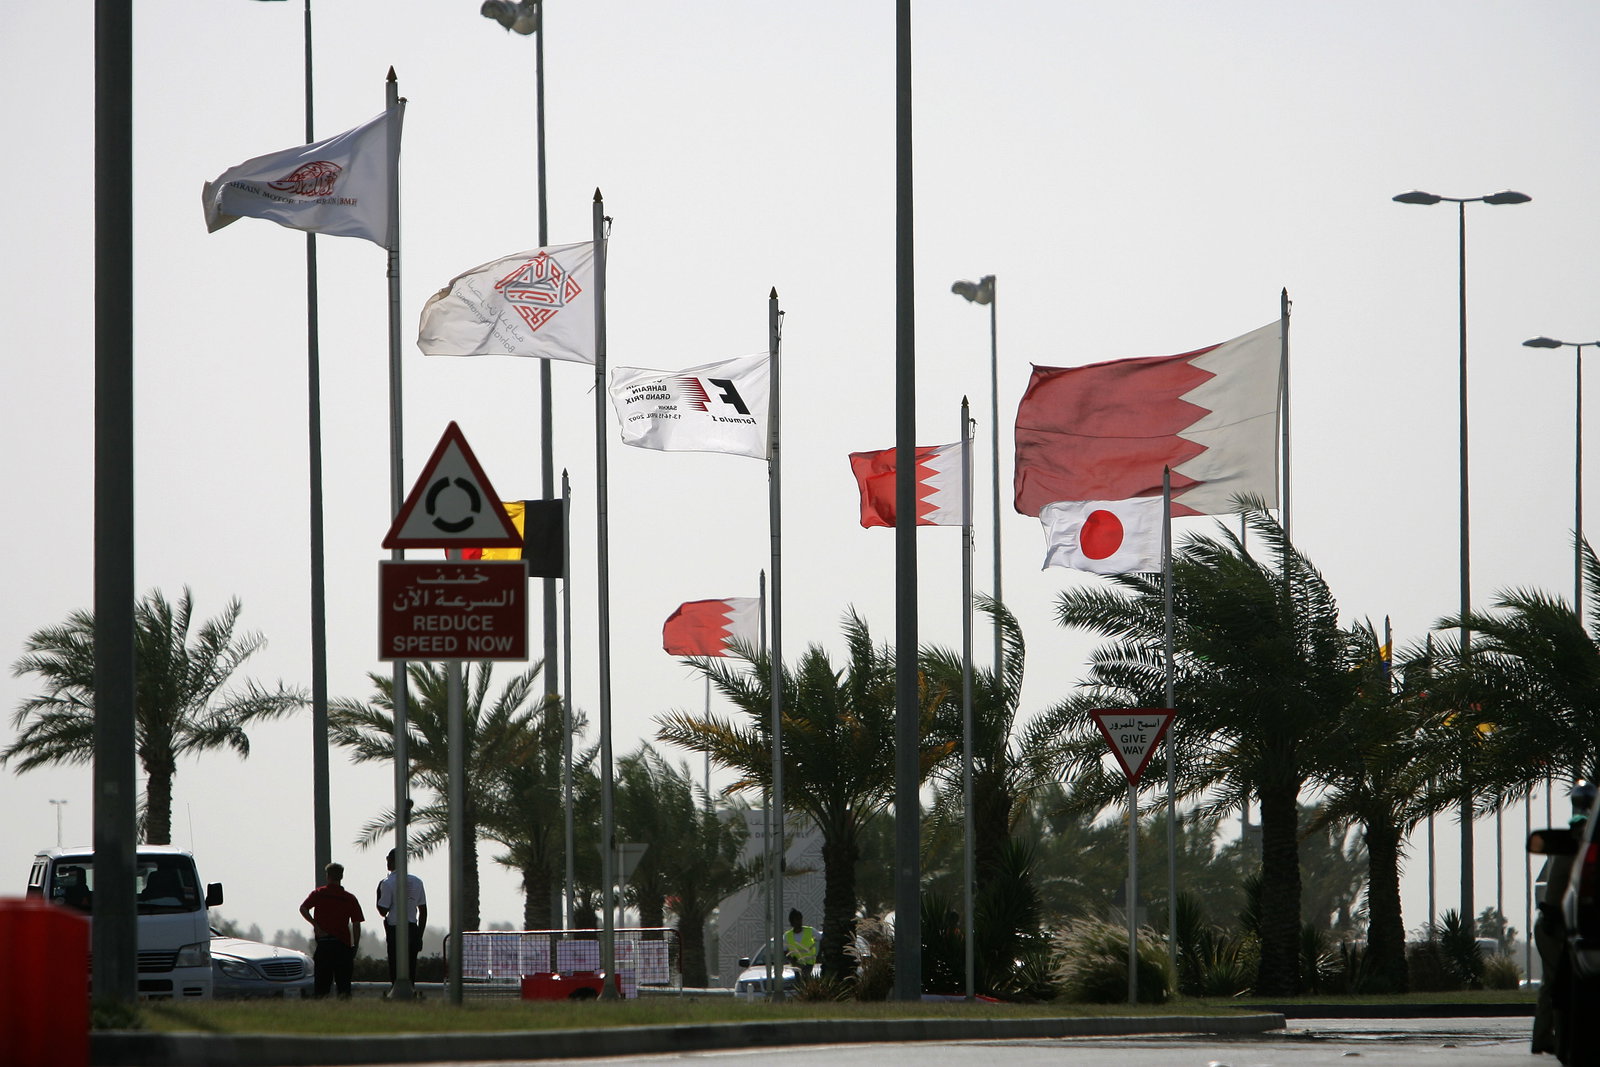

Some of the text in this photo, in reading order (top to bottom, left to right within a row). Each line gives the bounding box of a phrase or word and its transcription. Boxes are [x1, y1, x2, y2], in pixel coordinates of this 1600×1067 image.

[229, 182, 260, 196] AHRAIN
[416, 567, 490, 585] خفف
[434, 588, 515, 612] السرعة
[412, 615, 494, 632] REDUCE
[392, 635, 513, 652] SPEED NOW
[1120, 734, 1147, 744] GIVE
[1122, 745, 1145, 755] WAY
